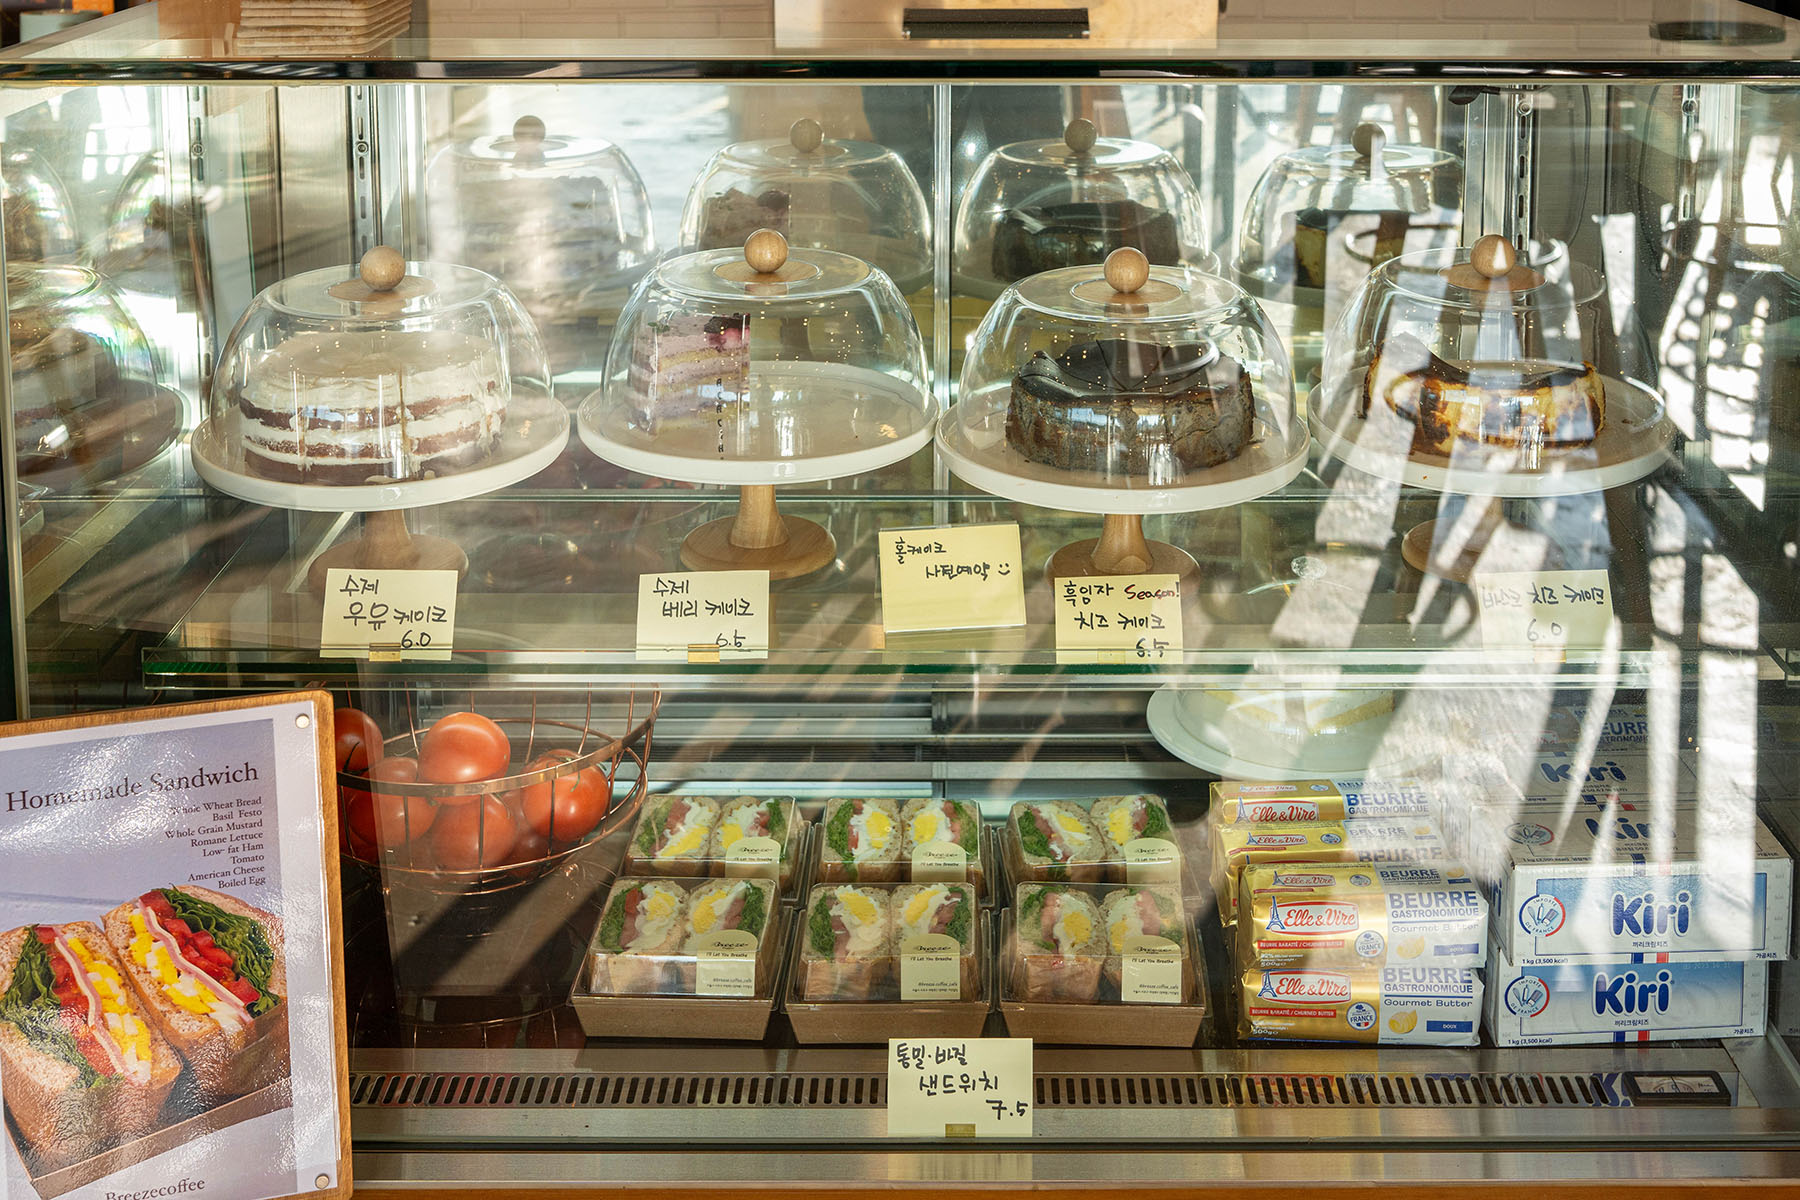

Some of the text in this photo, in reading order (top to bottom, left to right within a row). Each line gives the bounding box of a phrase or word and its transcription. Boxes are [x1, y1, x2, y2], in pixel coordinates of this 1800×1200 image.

[894, 536, 947, 565] 홀케이크
[925, 562, 991, 581] 사전예약
[339, 574, 380, 596] 수제
[653, 577, 690, 596] 수제
[1063, 580, 1181, 606] 흑임자 Season!
[1527, 582, 1559, 604] 치즈
[1563, 584, 1604, 605] 케이크
[342, 602, 448, 630] 우유 케이크
[662, 598, 755, 618] 베리 케이크
[1074, 613, 1167, 631] 치즈 케이크
[1526, 618, 1562, 641] 6.0
[401, 630, 432, 649] 6.0
[715, 631, 747, 649] 6.5
[1135, 637, 1170, 658] 6.5
[6, 762, 260, 813] Homemade Sandwich
[203, 801, 233, 811] Wheat
[236, 796, 262, 807] Bread
[1346, 792, 1429, 807] BEURRE
[213, 811, 234, 821] Basil
[165, 819, 263, 839] Whole Grain Mustard
[191, 832, 263, 847] Romane Lettuce
[228, 844, 239, 854] fat
[242, 842, 264, 852] Ham
[230, 855, 265, 865] Tomato
[187, 865, 265, 881] American Cheese
[218, 876, 266, 889] Boiled Egg
[1380, 868, 1439, 878] BEURRE
[1389, 891, 1478, 909] BEURRE
[1391, 908, 1479, 919] GASTRONOMIQUE
[1612, 891, 1690, 936] Kiri
[1383, 968, 1472, 983] BEURRE
[1384, 983, 1473, 993] GASTRONOMIQUE
[1594, 971, 1670, 1015] Kiri
[1384, 999, 1432, 1007] Gourmet
[1350, 1015, 1373, 1023] FRANCE
[919, 1070, 999, 1096] 샌드위치
[985, 1099, 1029, 1120] 7.5
[106, 1178, 206, 1200] Breezecoffee
